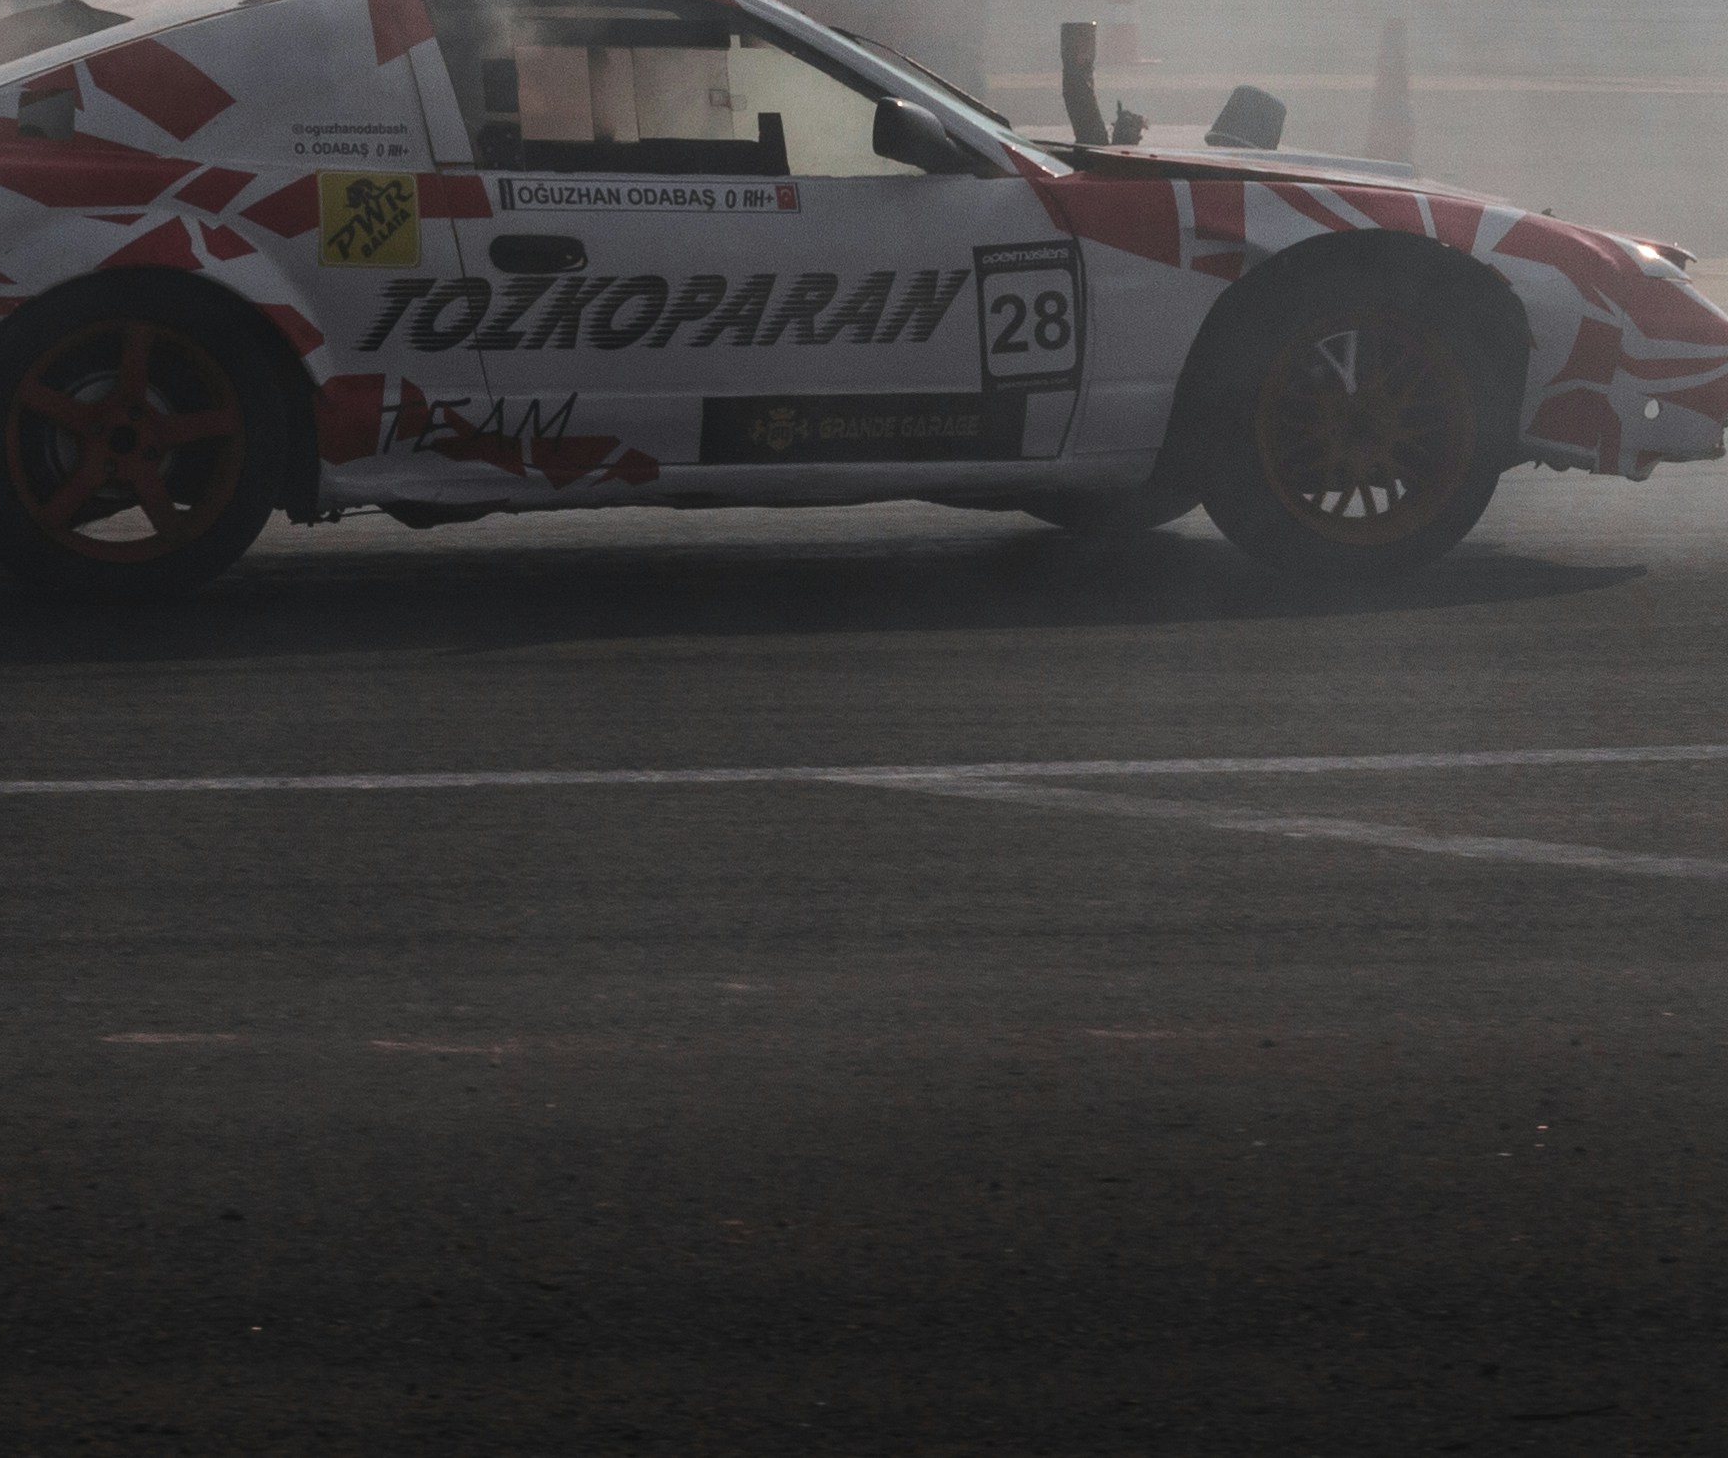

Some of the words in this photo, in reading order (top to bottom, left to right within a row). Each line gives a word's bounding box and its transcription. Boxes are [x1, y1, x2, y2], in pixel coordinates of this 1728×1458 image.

[312, 142, 370, 159] ODABAŞ
[327, 178, 414, 260] PWR
[517, 183, 622, 206] OĞUZHAN
[627, 187, 716, 211] ODABAŞ
[742, 189, 775, 208] RH+
[355, 269, 971, 352] TOZKOPARAN
[990, 290, 1071, 355] 28
[376, 392, 579, 454] TEAM
[819, 416, 897, 440] GRANDE
[901, 414, 981, 438] GARAGE
